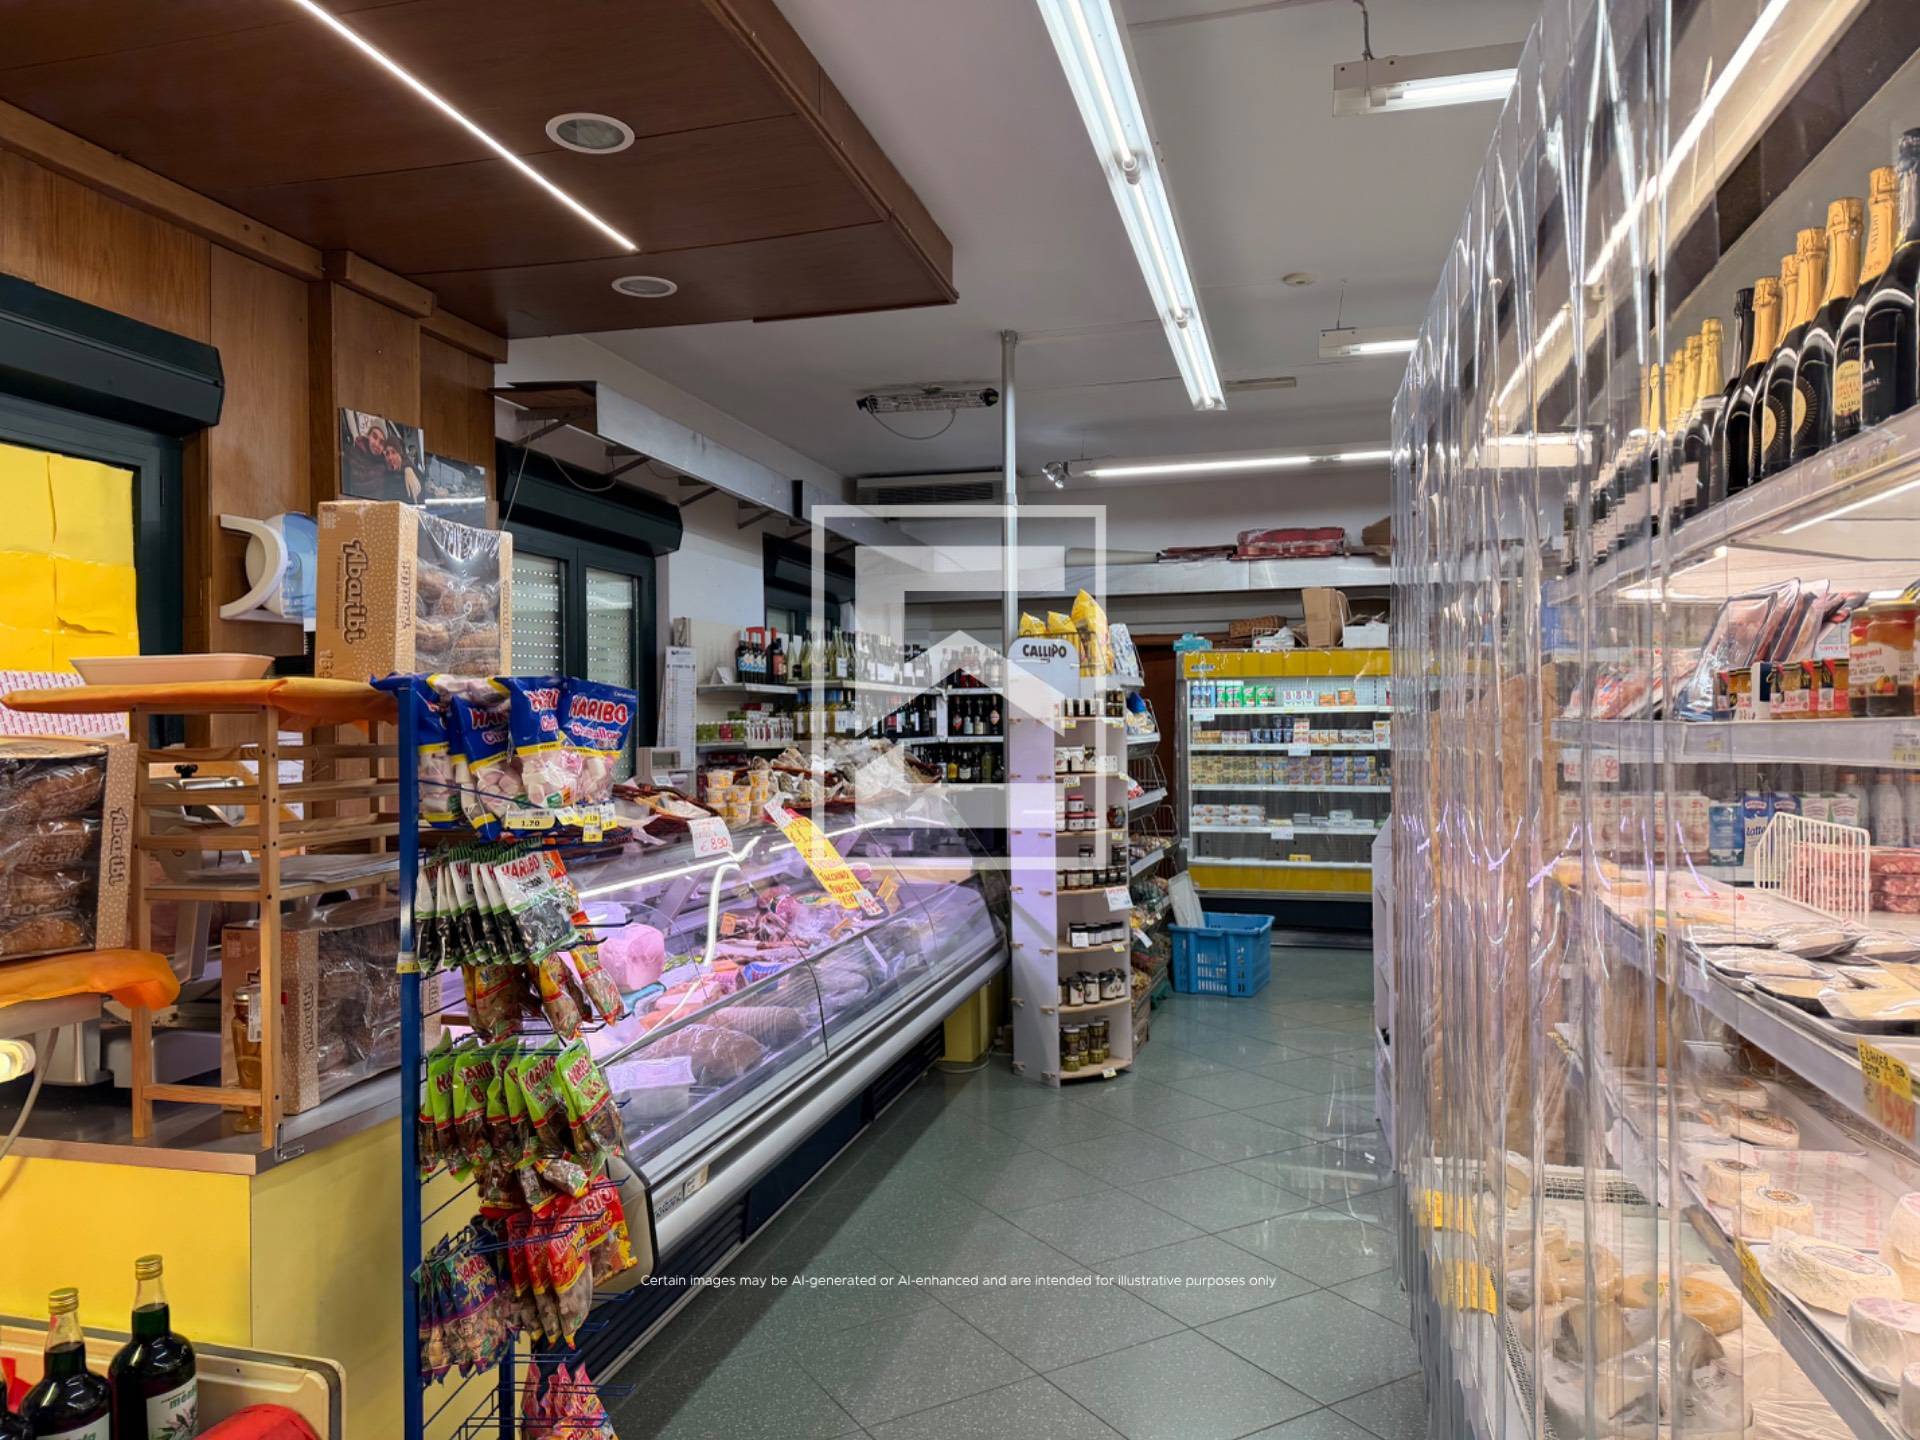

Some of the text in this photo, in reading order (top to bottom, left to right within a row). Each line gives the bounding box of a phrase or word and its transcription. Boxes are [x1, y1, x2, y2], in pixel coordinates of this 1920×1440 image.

[343, 540, 369, 645] Abaribi
[1022, 643, 1067, 658] CALLIPO
[569, 694, 629, 726] HARIBO
[521, 819, 541, 827] 1.70
[108, 807, 129, 887] Abaribi
[500, 854, 541, 879] HARIBO
